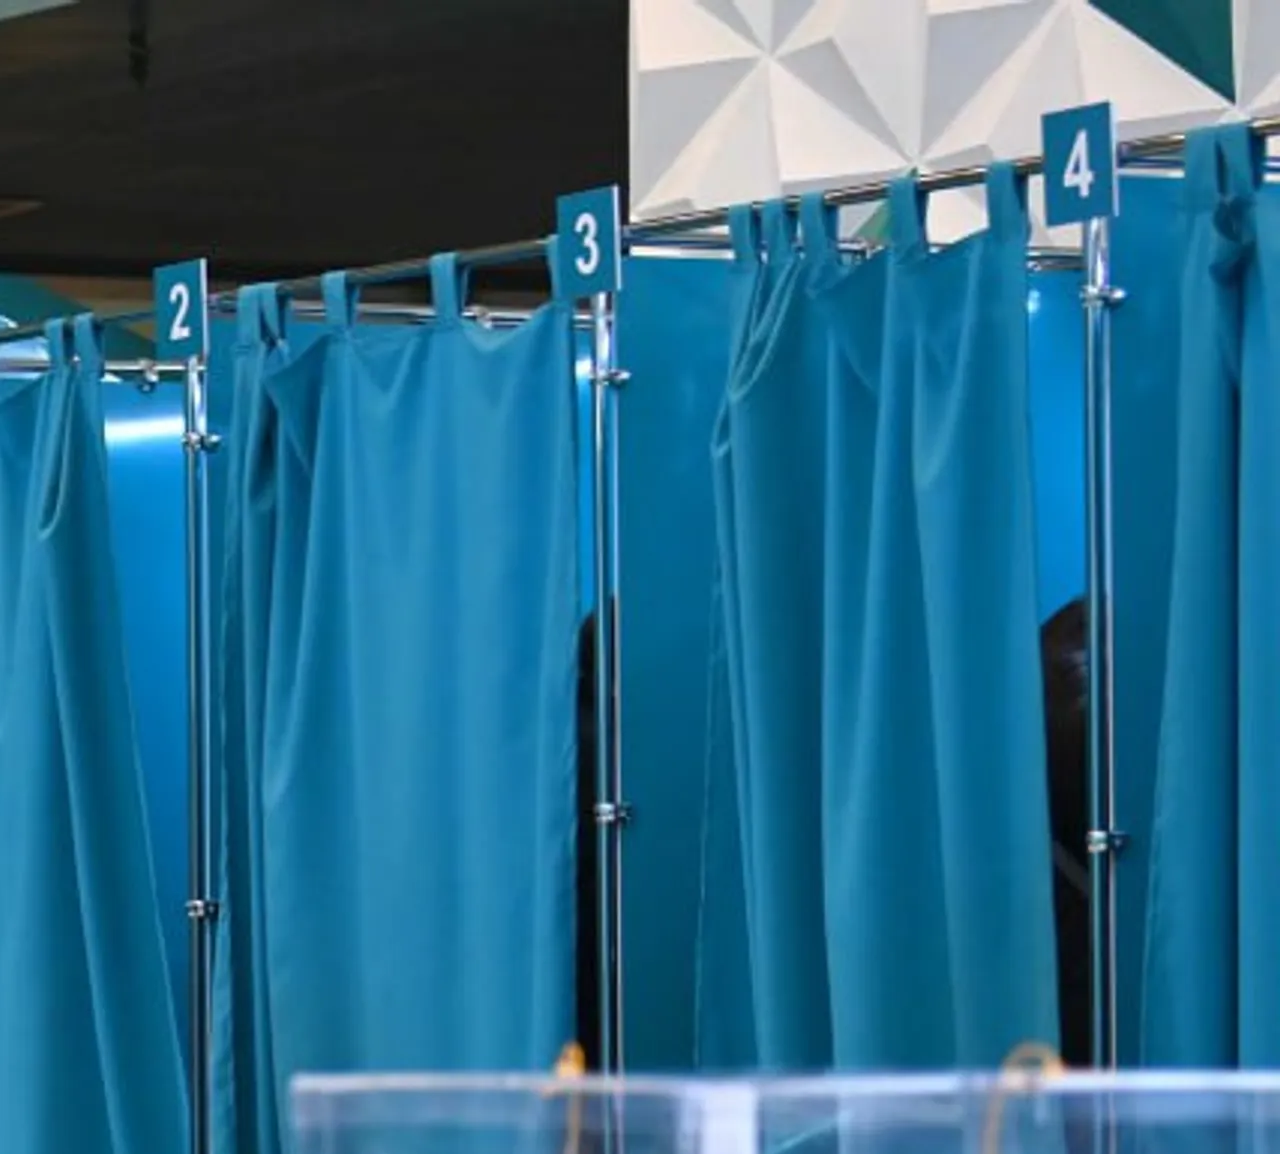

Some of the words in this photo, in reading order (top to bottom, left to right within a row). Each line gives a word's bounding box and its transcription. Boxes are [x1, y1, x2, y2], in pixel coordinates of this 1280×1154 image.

[1063, 128, 1095, 198] 4
[574, 212, 600, 275] 3
[169, 282, 191, 341] 2
